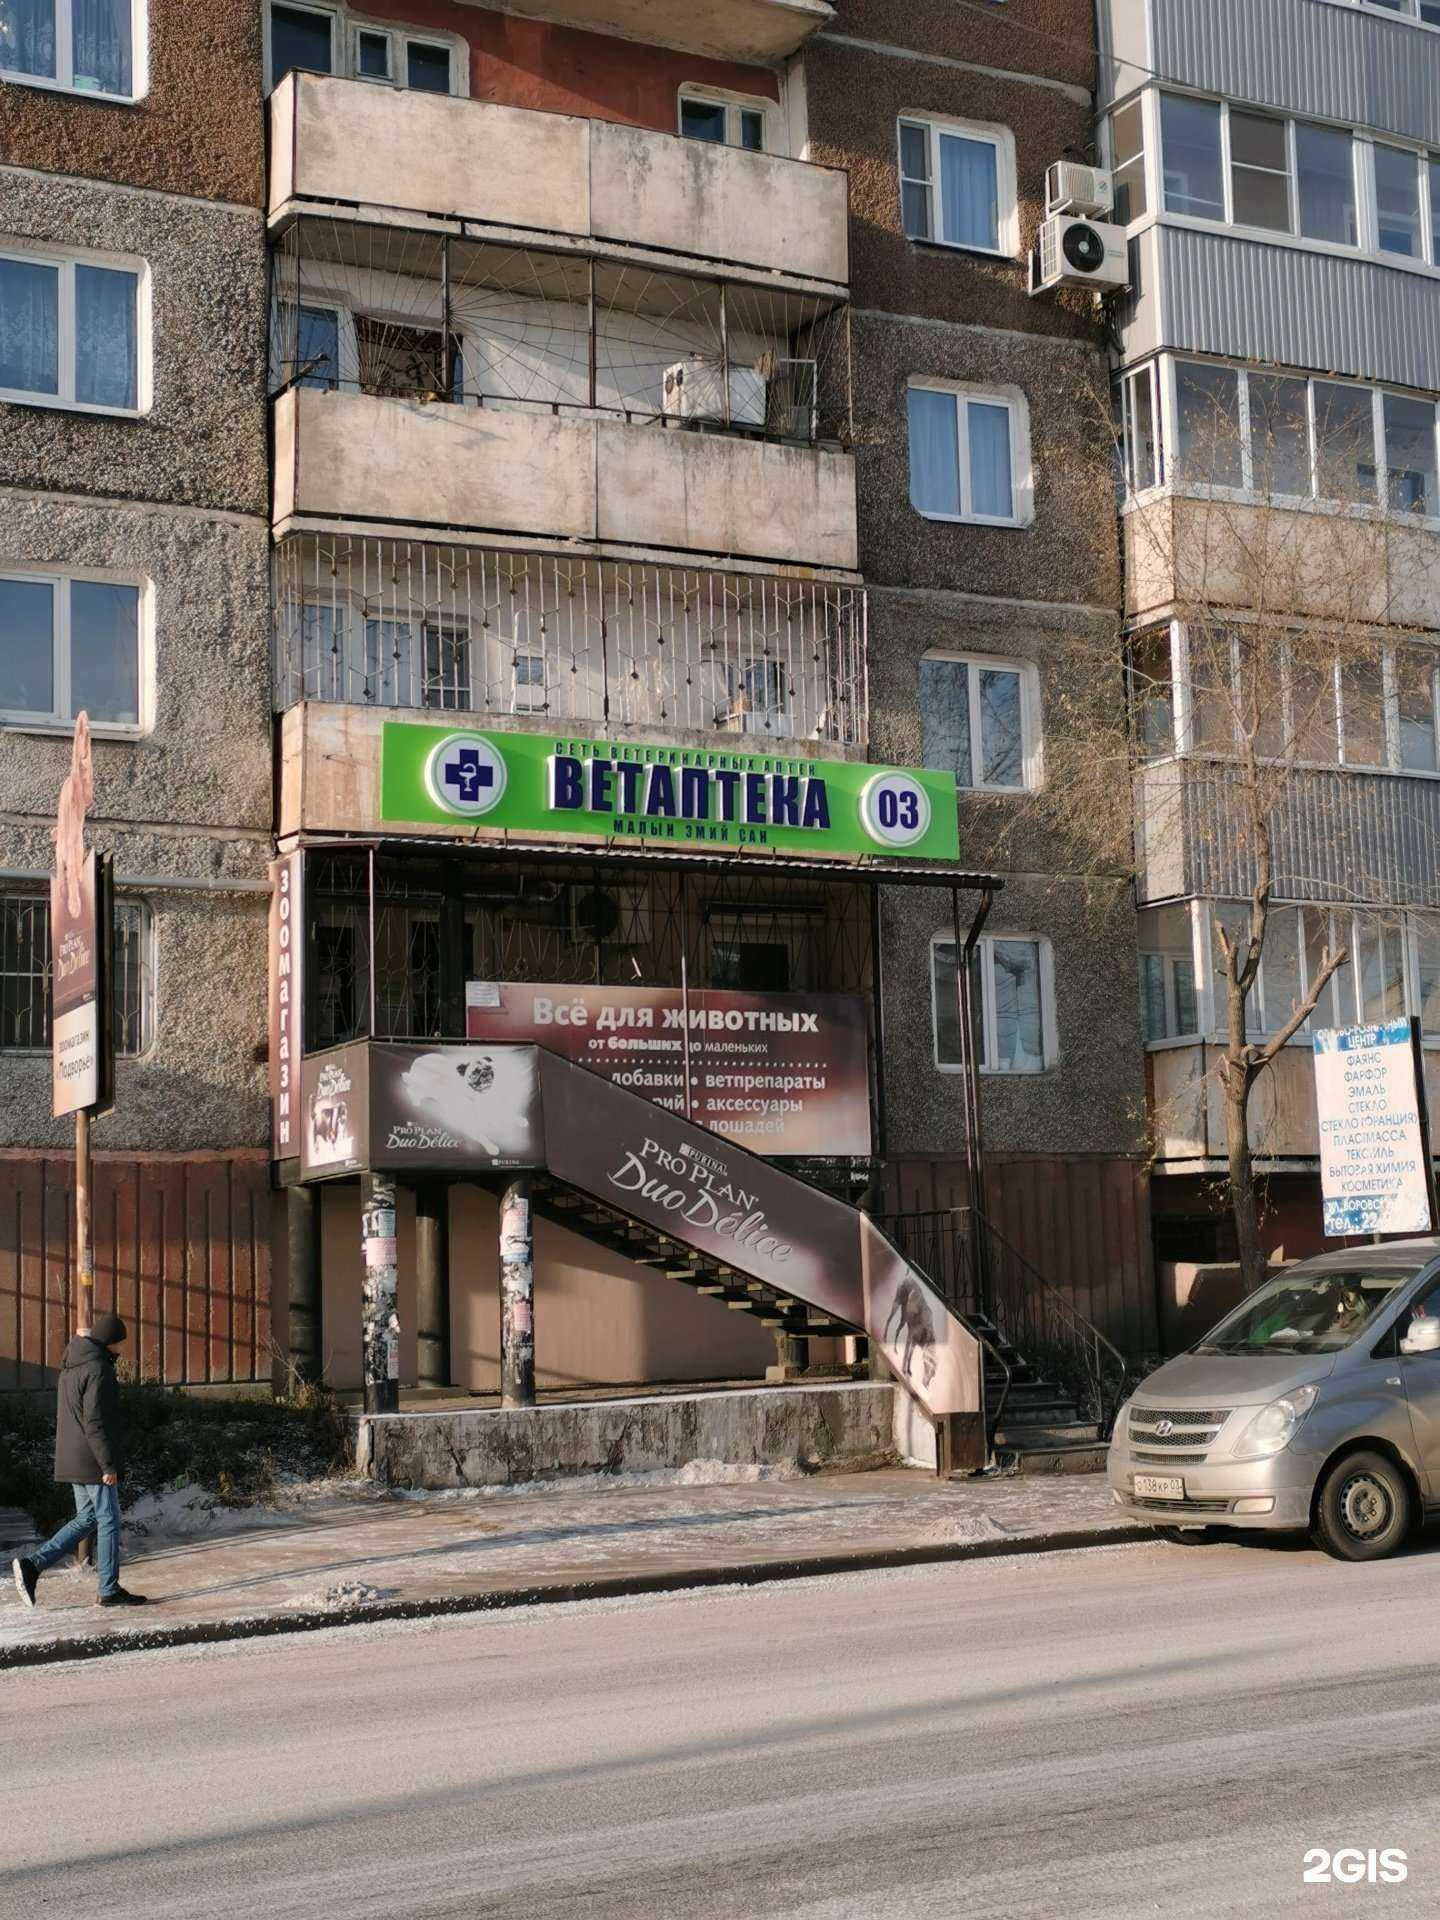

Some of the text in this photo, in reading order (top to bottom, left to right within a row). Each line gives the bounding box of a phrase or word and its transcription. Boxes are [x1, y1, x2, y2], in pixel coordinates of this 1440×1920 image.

[555, 742, 600, 757] СЕТЬ
[610, 746, 755, 770] ВЕТЕРИНАРНЫХ
[549, 755, 831, 830] ВЕТАПТЕКА
[879, 789, 919, 829] 03
[613, 819, 675, 837] МАЛЫН
[738, 828, 768, 843] САН
[533, 998, 819, 1033] Всё для животных
[588, 1039, 605, 1050] от
[607, 1036, 682, 1051] больших
[704, 1042, 768, 1054] маленьких
[1347, 1033, 1377, 1049] ЦЕНТР
[1346, 1051, 1382, 1066] ФАЯНС
[705, 1074, 826, 1093] ветпрепараты
[1344, 1067, 1388, 1082] ФАРФОР
[1348, 1083, 1386, 1098] ЭМАЛЬ
[706, 1099, 803, 1117] аксессуары
[1348, 1099, 1387, 1114] СТЕКЛО
[709, 1118, 785, 1135] лошадей
[1321, 1118, 1359, 1132] СТЕКЛО
[386, 1133, 417, 1149] Duo
[607, 1151, 687, 1211] Duo
[639, 1137, 756, 1211] PRO PLAN
